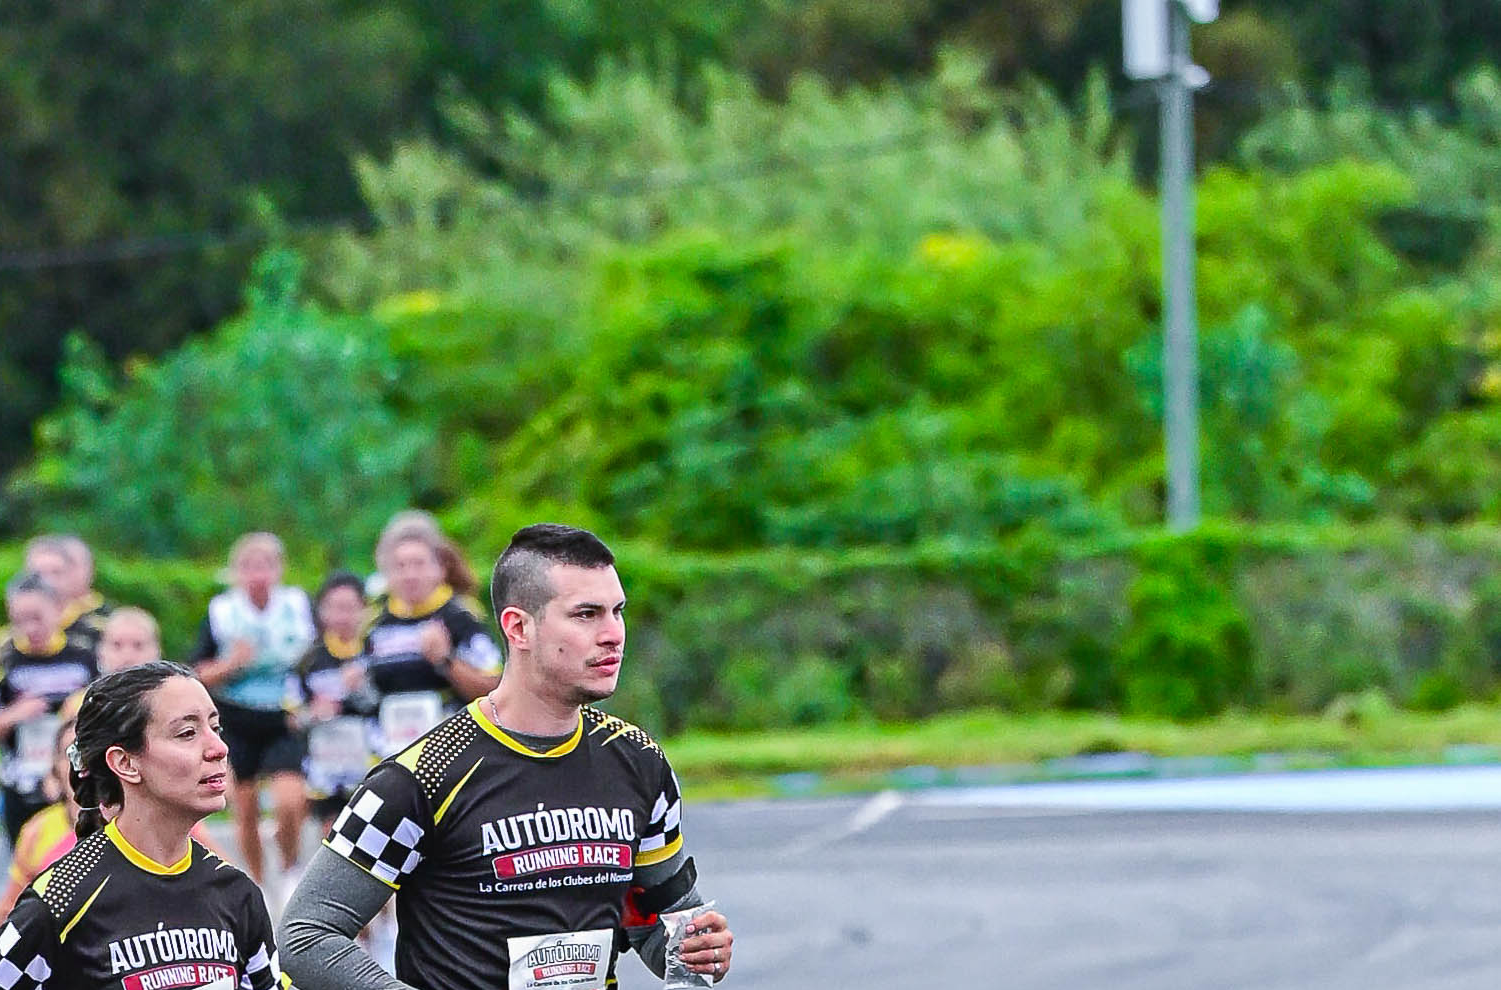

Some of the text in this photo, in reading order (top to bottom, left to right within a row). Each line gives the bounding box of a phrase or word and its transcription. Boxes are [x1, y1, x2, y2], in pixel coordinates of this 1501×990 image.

[481, 803, 636, 856] AUTÓDROMO
[512, 846, 620, 875] RUNNING RACE
[479, 882, 492, 893] La
[495, 882, 533, 893] Carrera
[535, 878, 547, 889] de
[548, 877, 562, 888] los
[563, 875, 593, 886] Clubes
[595, 872, 609, 884] del
[109, 922, 237, 974] AUTÓDROMO
[528, 940, 601, 968] AUTÓDROMO
